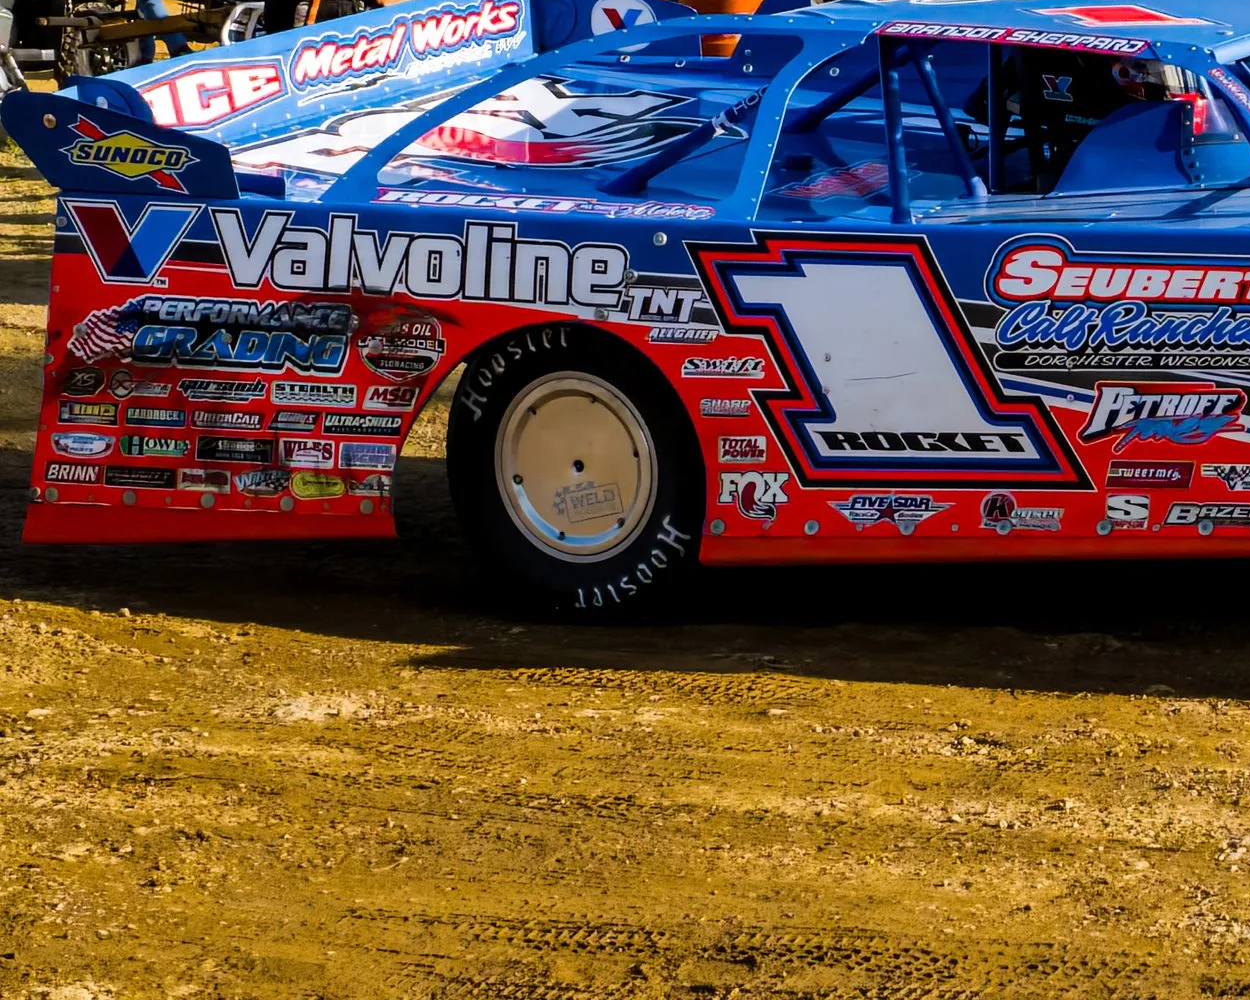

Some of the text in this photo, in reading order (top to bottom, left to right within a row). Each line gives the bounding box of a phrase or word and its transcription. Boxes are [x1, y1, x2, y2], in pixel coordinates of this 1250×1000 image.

[294, 21, 406, 81] Metal
[411, 0, 520, 55] Works
[886, 22, 1146, 53] BRANDON SHEPPARD
[77, 142, 186, 169] SUNOCO
[377, 190, 582, 212] ROCKET
[212, 209, 630, 309] Valvoline
[142, 298, 355, 330] PERFORMANCE
[628, 288, 702, 323] TNT
[412, 323, 432, 336] OIL
[648, 326, 720, 341] ALLGAIER
[997, 301, 1097, 351] Calf
[131, 324, 348, 370] GRADING
[461, 326, 571, 422] Hoosier
[683, 357, 764, 374] Swift
[701, 399, 751, 409] SHARP
[1082, 386, 1239, 437] PETROFF
[283, 440, 333, 460] WILES
[720, 437, 760, 449] TOTAL
[721, 448, 765, 459] POWER
[813, 431, 1027, 453] ROCKET
[47, 464, 99, 482] BRINN
[718, 470, 790, 512] FOX
[850, 496, 932, 510] FIVE STAR
[575, 515, 691, 608] Hoosier
